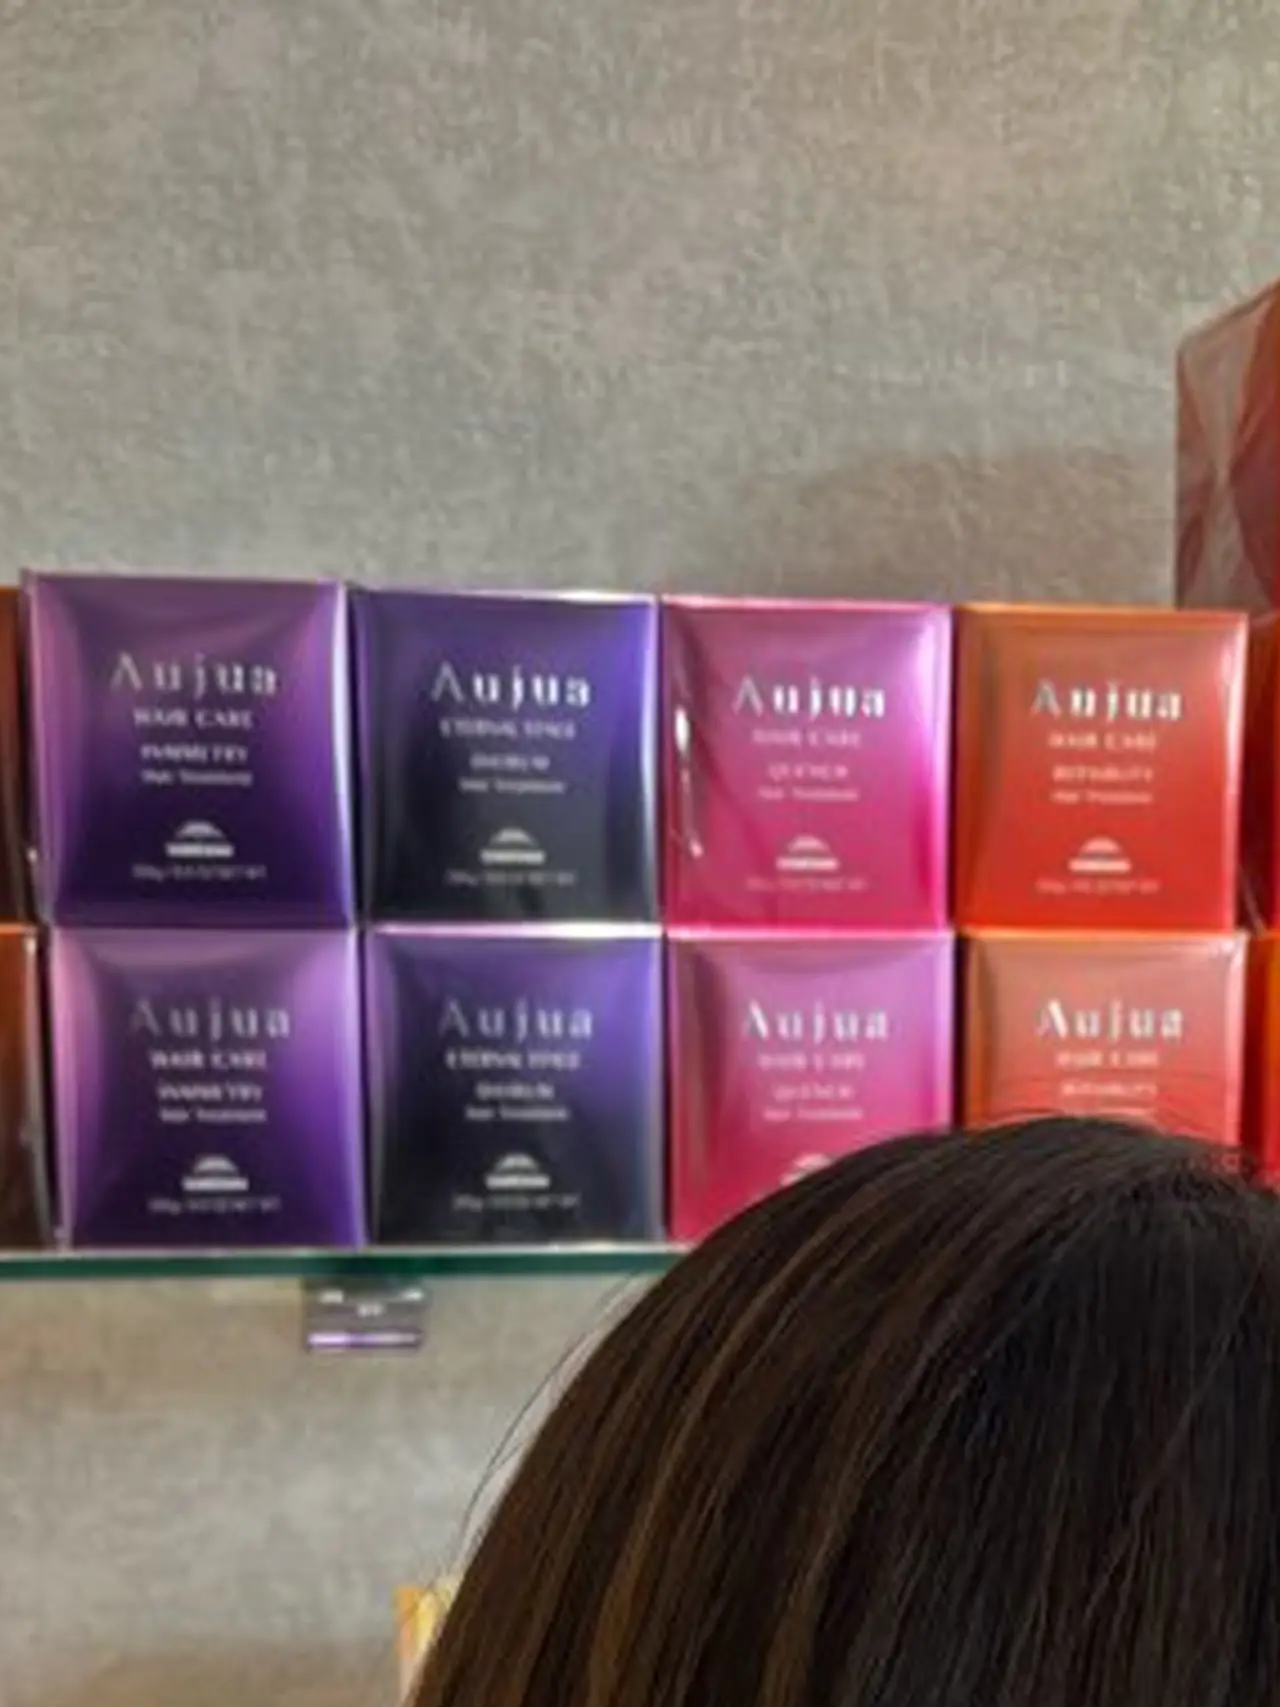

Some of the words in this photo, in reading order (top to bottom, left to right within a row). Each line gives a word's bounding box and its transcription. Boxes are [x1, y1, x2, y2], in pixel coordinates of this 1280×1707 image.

[110, 652, 278, 700] Aujua
[431, 659, 591, 712] Aujua
[732, 674, 886, 719] Aujua
[133, 707, 187, 728] HAIR
[195, 709, 254, 730] CARE
[1030, 678, 1183, 722] Aujua
[131, 998, 290, 1042] Aujua
[438, 998, 593, 1044] Aujua
[746, 1001, 888, 1044] Aujua
[1036, 999, 1183, 1042] Aujua
